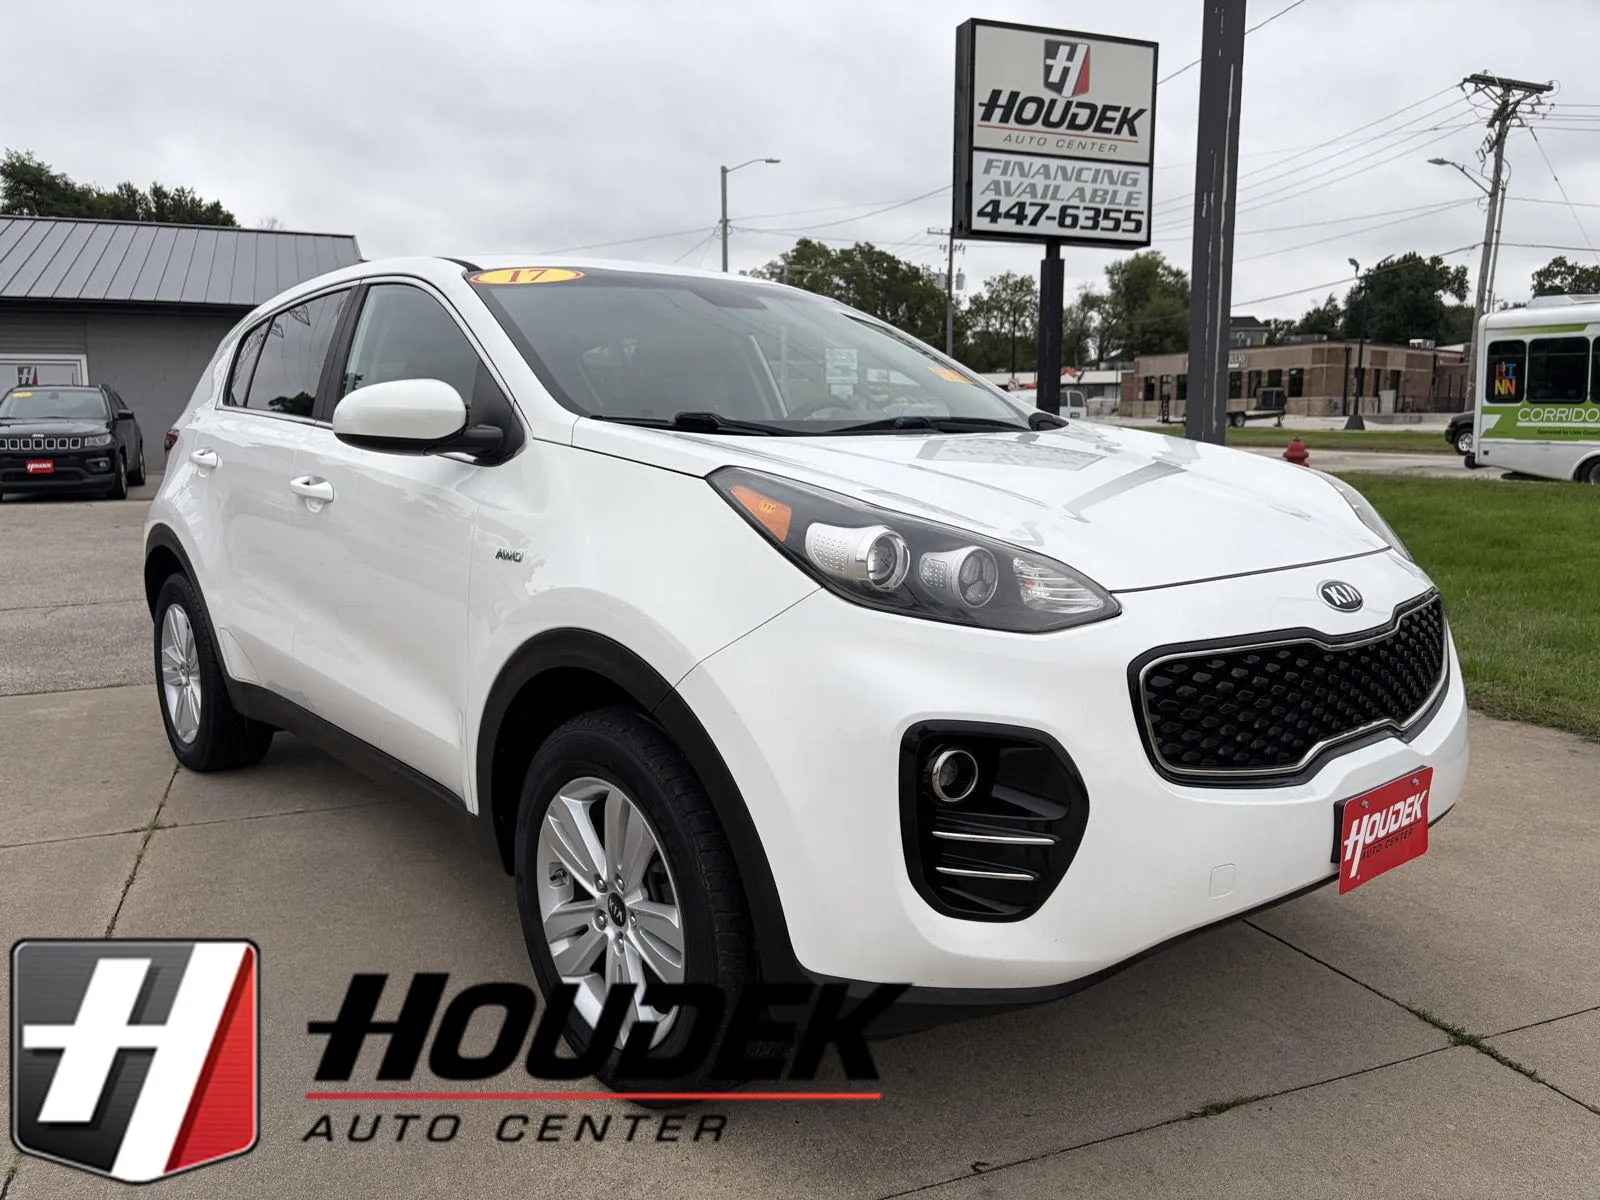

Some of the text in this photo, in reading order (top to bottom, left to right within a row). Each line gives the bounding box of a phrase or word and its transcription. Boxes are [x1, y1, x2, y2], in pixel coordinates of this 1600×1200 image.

[978, 89, 1147, 137] HOUDEK
[1003, 133, 1118, 153] AUTO CENTER
[982, 158, 1140, 187] FINANCING
[980, 179, 1142, 207] AVAILABLE
[976, 199, 1144, 234] 447-6355
[508, 269, 549, 283] 17
[1323, 584, 1361, 606] KIA
[1344, 790, 1428, 879] HOUDEK
[1360, 827, 1414, 861] AUTO CENTER
